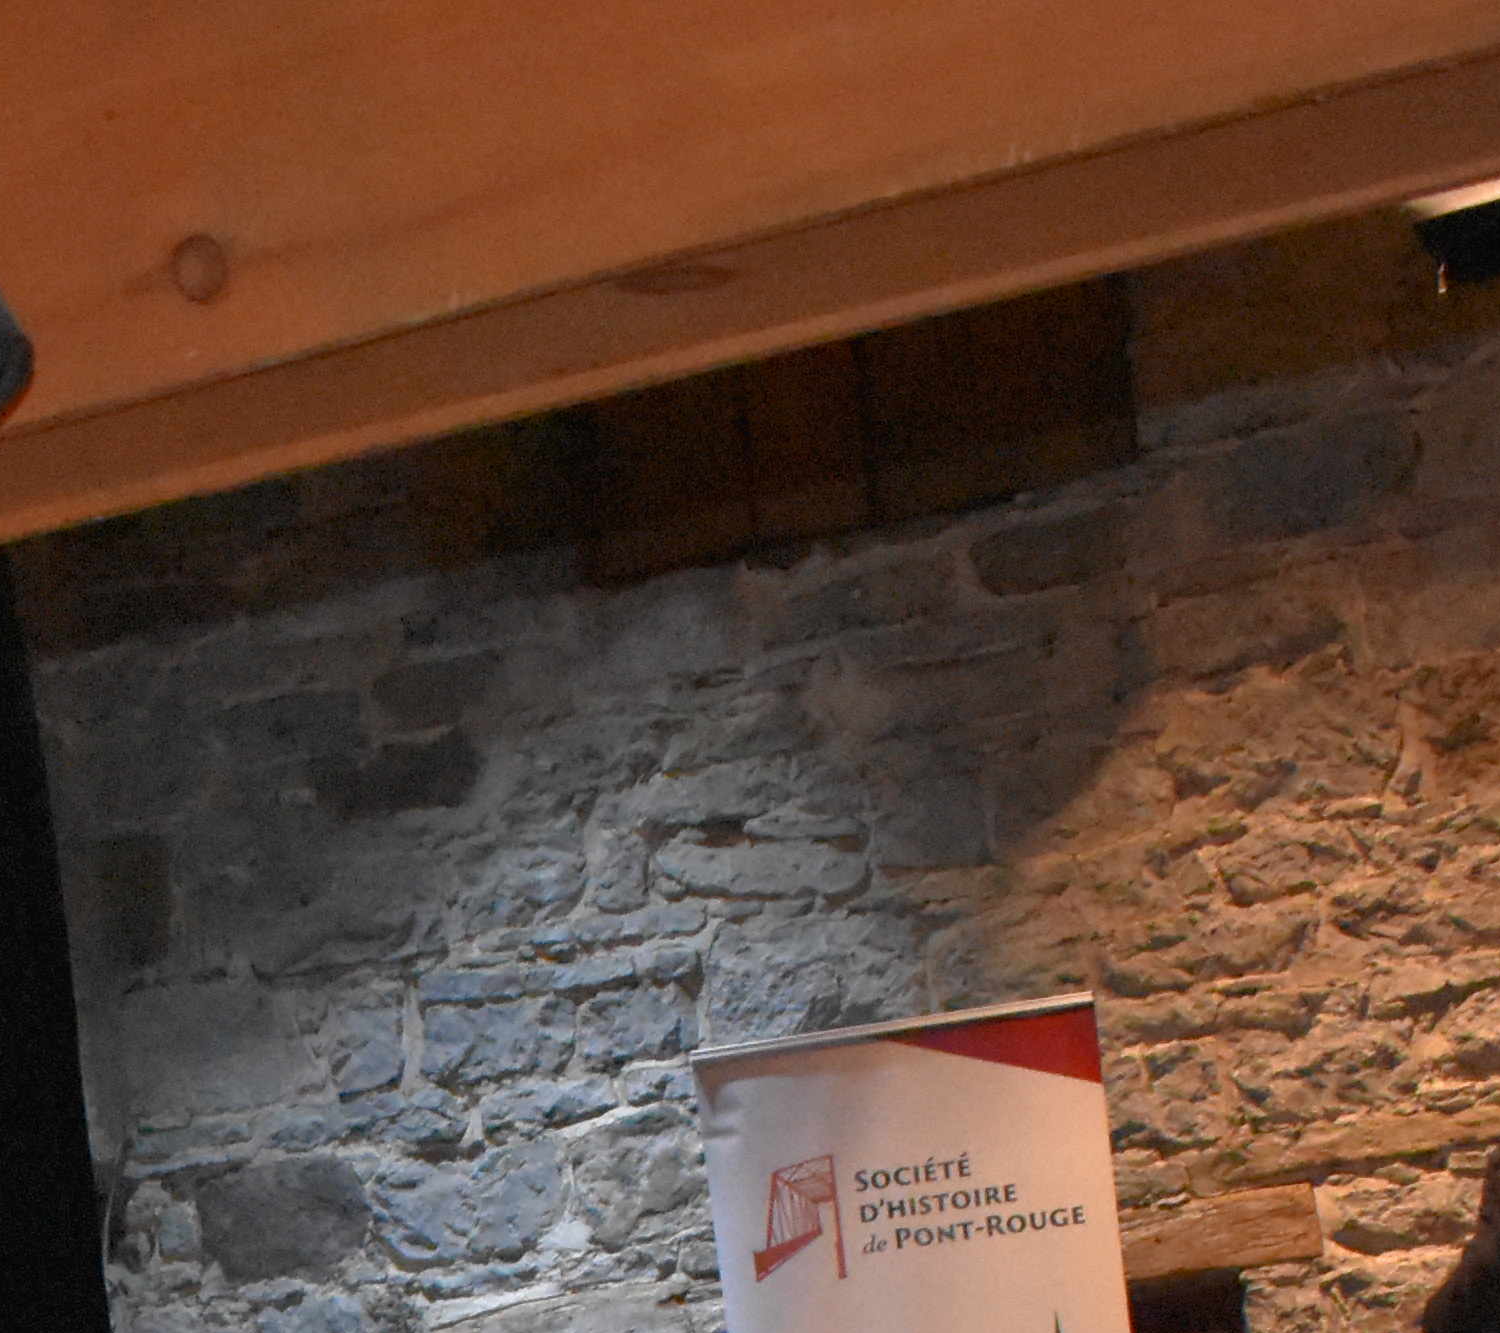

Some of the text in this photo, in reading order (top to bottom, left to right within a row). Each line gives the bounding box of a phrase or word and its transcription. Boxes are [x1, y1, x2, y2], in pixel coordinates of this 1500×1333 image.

[854, 1151, 972, 1192] SOCIÉTÉ
[859, 1183, 1018, 1223] D'HISTOIRE
[862, 1205, 1086, 1254] de PONT-ROUGE
